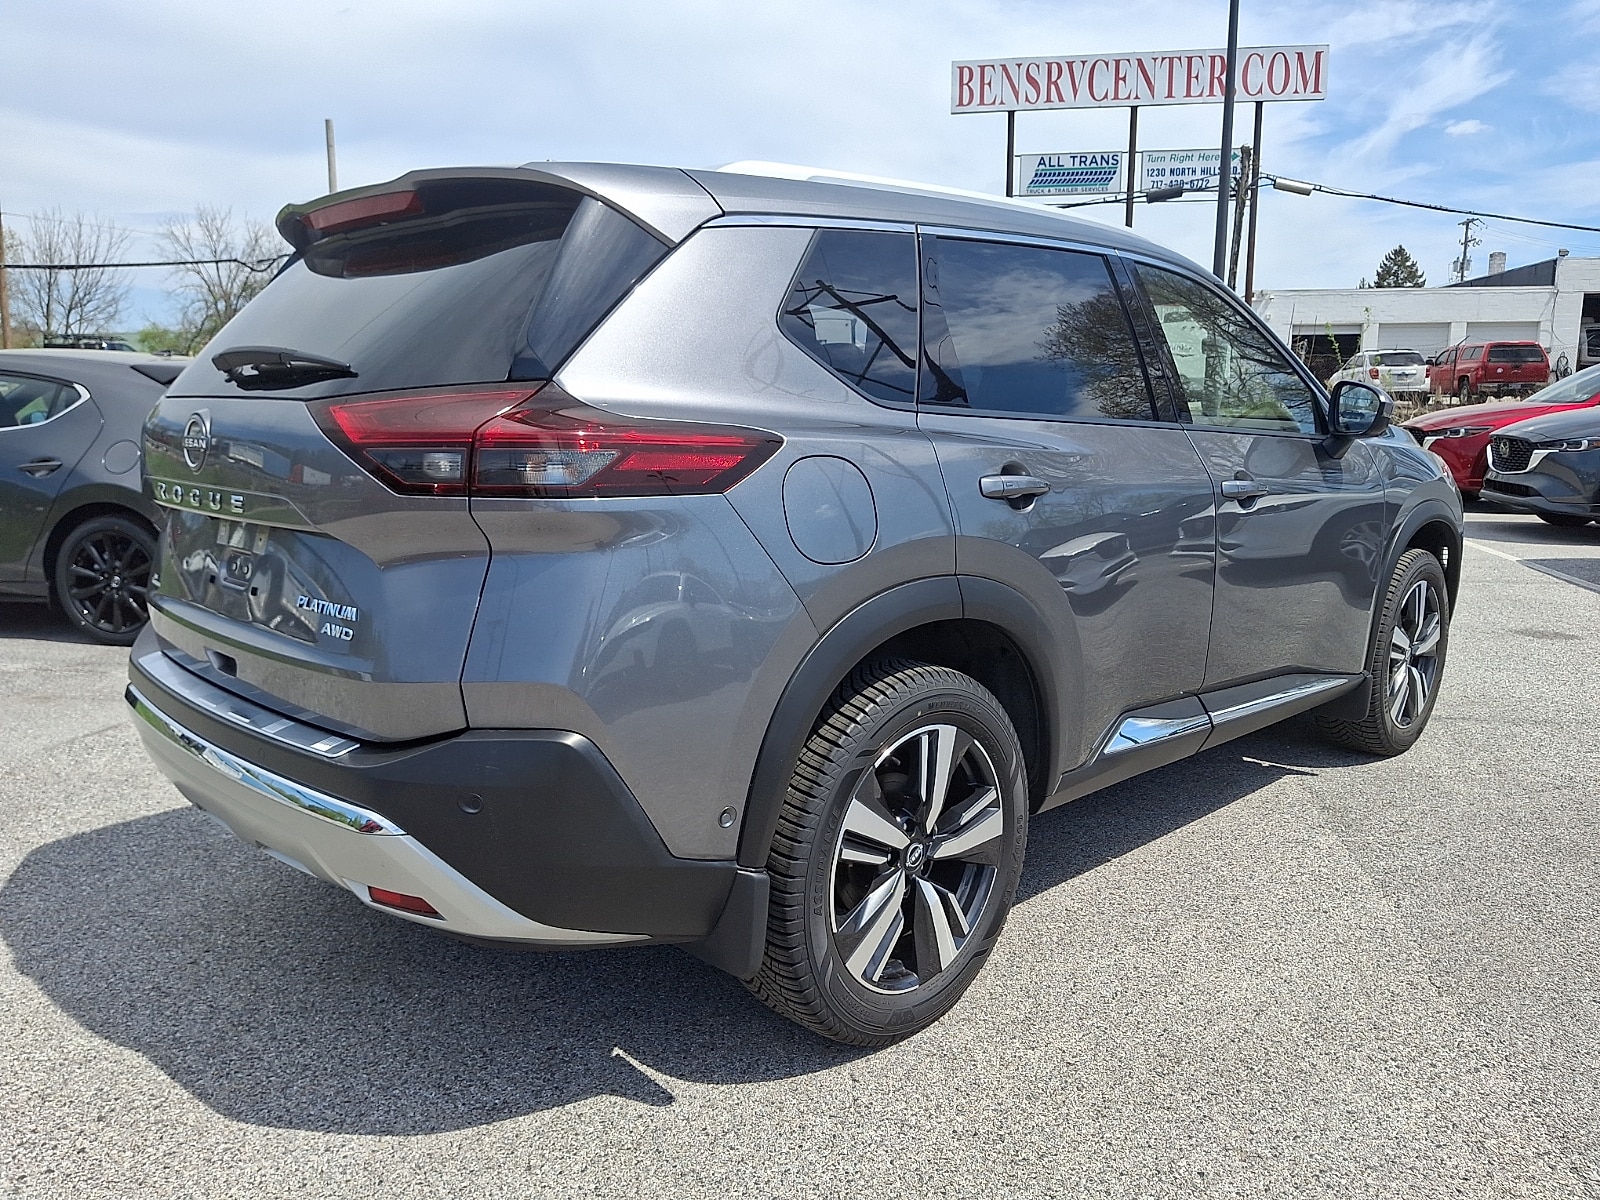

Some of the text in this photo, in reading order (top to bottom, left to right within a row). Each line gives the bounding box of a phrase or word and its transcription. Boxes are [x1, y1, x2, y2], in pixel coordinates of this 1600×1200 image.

[1037, 154, 1119, 168] ALL TRANS
[1146, 152, 1220, 164] Turn Right Here
[1146, 168, 1166, 177] 1230
[1169, 166, 1196, 177] NORTH
[157, 482, 244, 514] ROGUE
[296, 595, 358, 622] PLATINUM
[320, 622, 354, 641] AWD
